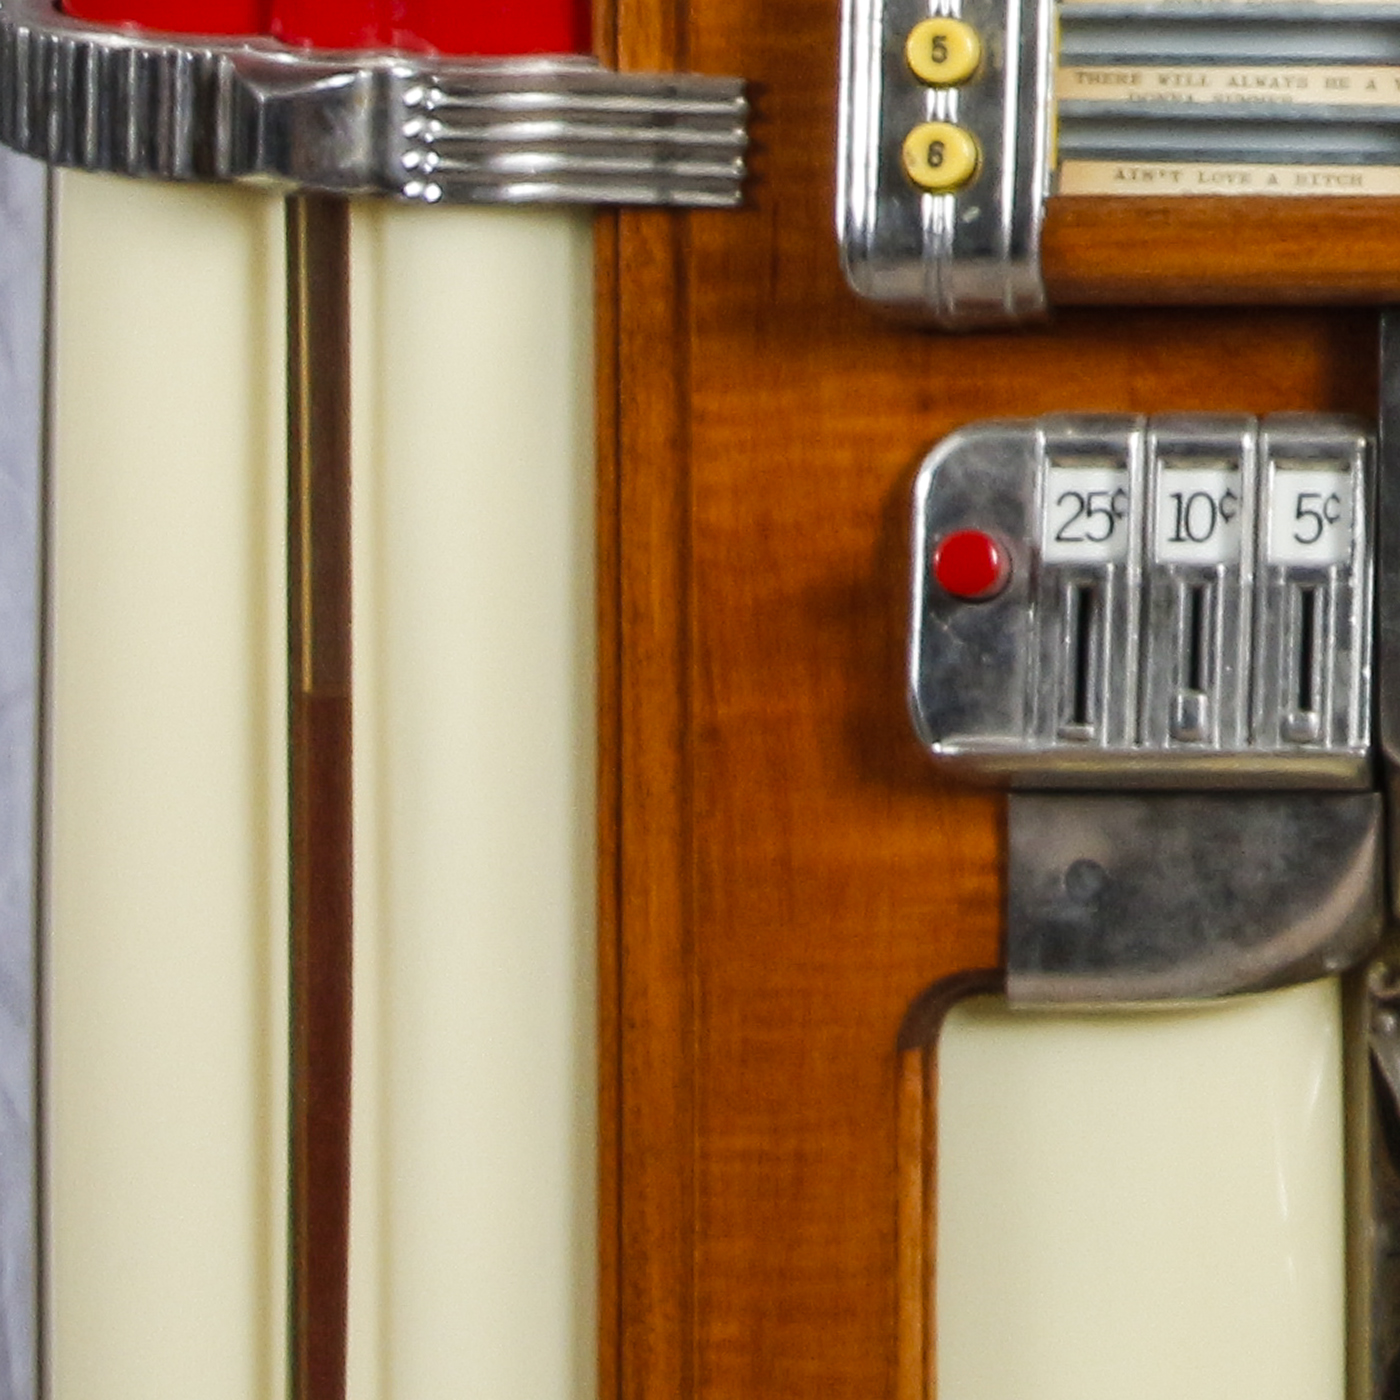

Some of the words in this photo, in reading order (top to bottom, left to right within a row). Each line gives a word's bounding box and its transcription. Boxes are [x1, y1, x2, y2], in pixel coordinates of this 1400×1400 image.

[931, 35, 947, 64] 5
[1075, 72, 1142, 85] THERE
[1158, 74, 1210, 86] WILL
[1226, 76, 1308, 89] ALWAYS
[1324, 78, 1350, 89] BE
[1365, 78, 1377, 89] A
[927, 140, 943, 168] 6
[1198, 171, 1251, 184] LOVE
[1267, 173, 1280, 185] A
[1055, 487, 1128, 543] 25¢
[1166, 486, 1239, 544] 10¢
[1294, 491, 1342, 545] 5¢
